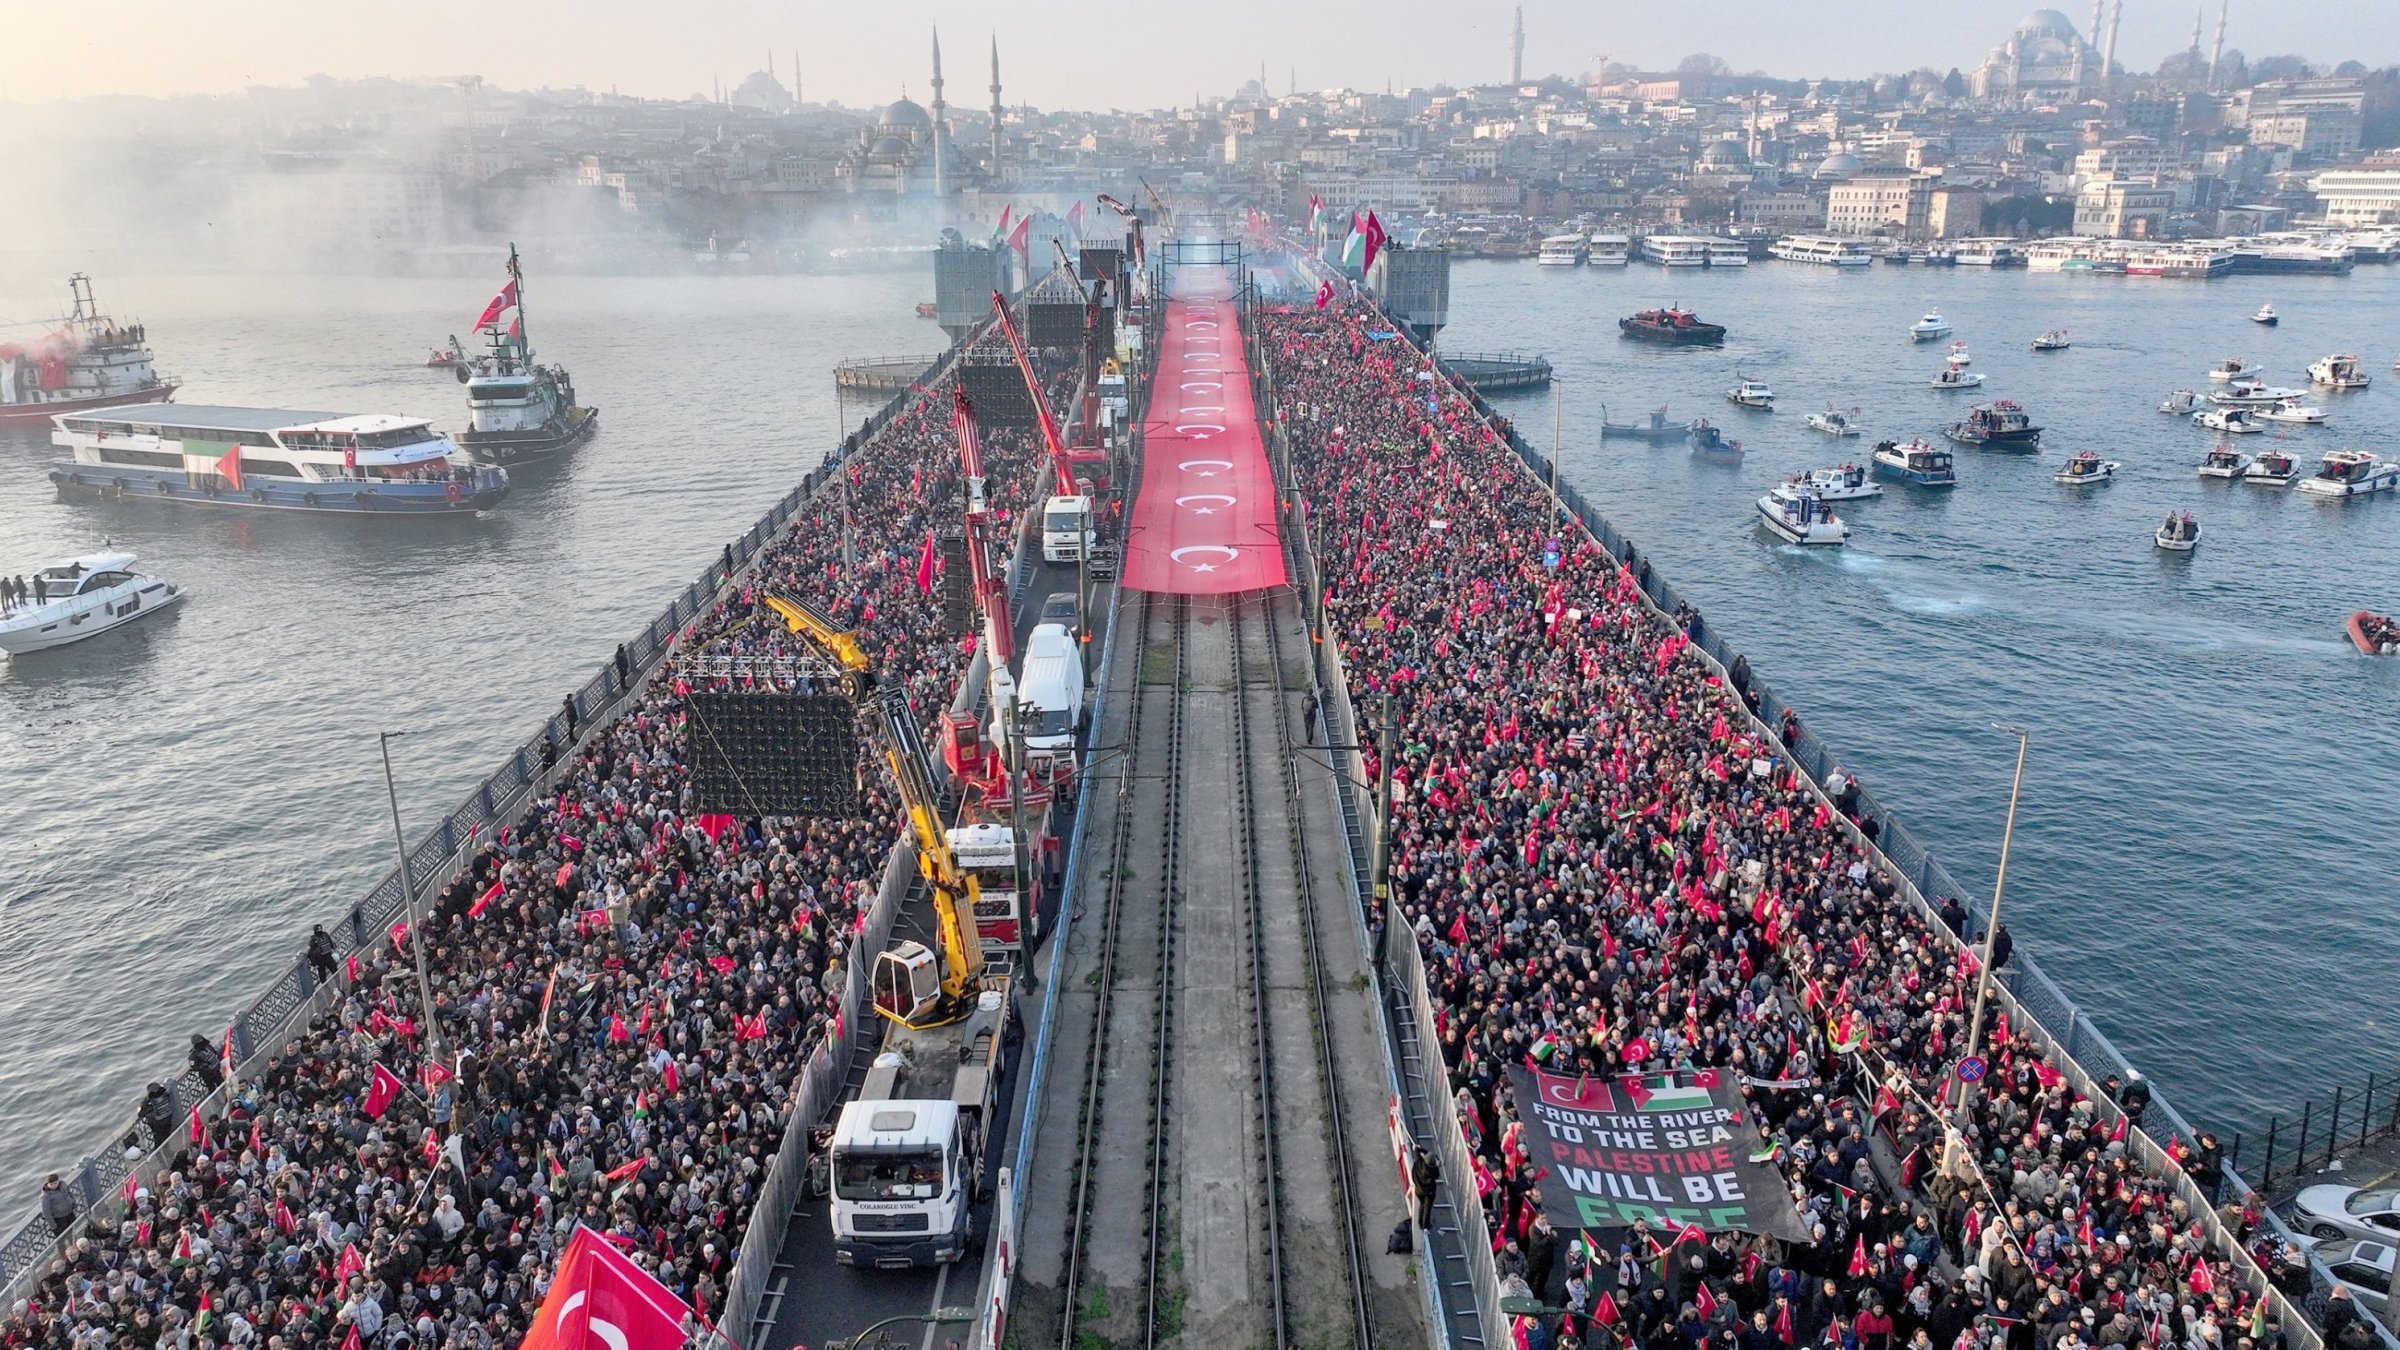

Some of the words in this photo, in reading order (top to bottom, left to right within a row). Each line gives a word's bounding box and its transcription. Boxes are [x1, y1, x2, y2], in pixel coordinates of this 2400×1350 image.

[1532, 1102, 1600, 1127] FROM
[1606, 1115, 1654, 1129] THE
[1659, 1108, 1731, 1129] RIVER
[1542, 1119, 1584, 1144] TO
[1591, 1129, 1658, 1150] THE
[1665, 1125, 1733, 1149] SEA
[1550, 1141, 1735, 1174] PALESTINE
[1556, 1164, 1674, 1203] WILL
[1681, 1171, 1746, 1203] BE
[1573, 1195, 1749, 1231] FREE
